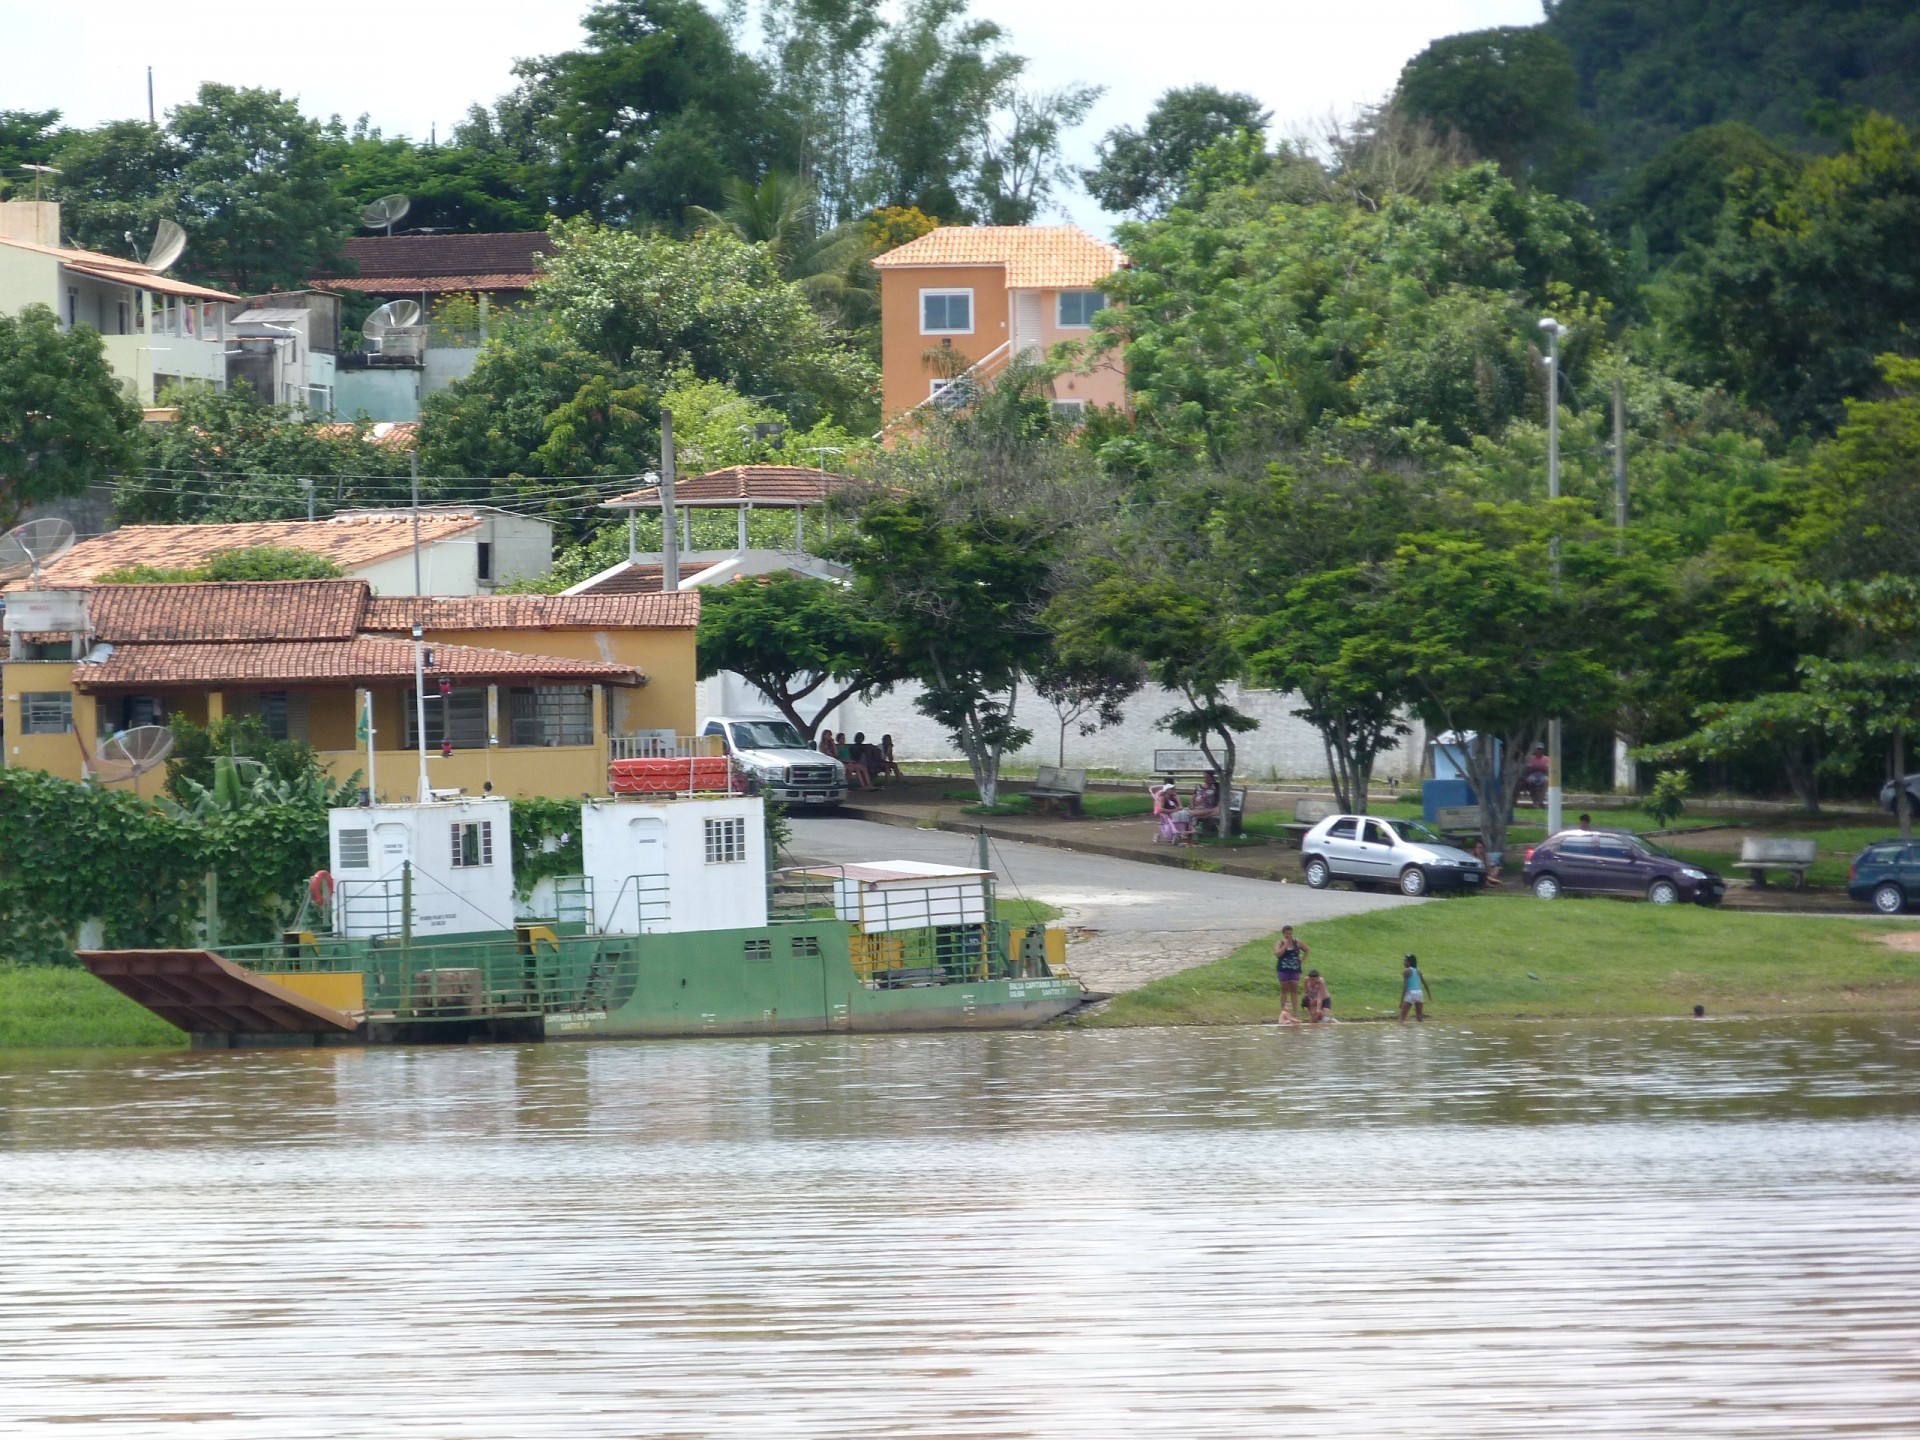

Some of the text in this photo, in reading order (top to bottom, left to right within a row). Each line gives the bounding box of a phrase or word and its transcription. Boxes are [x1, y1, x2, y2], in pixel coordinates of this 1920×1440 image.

[1025, 981, 1051, 989] CAPITANIA
[1042, 988, 1060, 996] SANTOS
[545, 1015, 572, 1023] CAPITANIA
[586, 1012, 607, 1021] PORTOS
[561, 1022, 581, 1030] SANTOS
